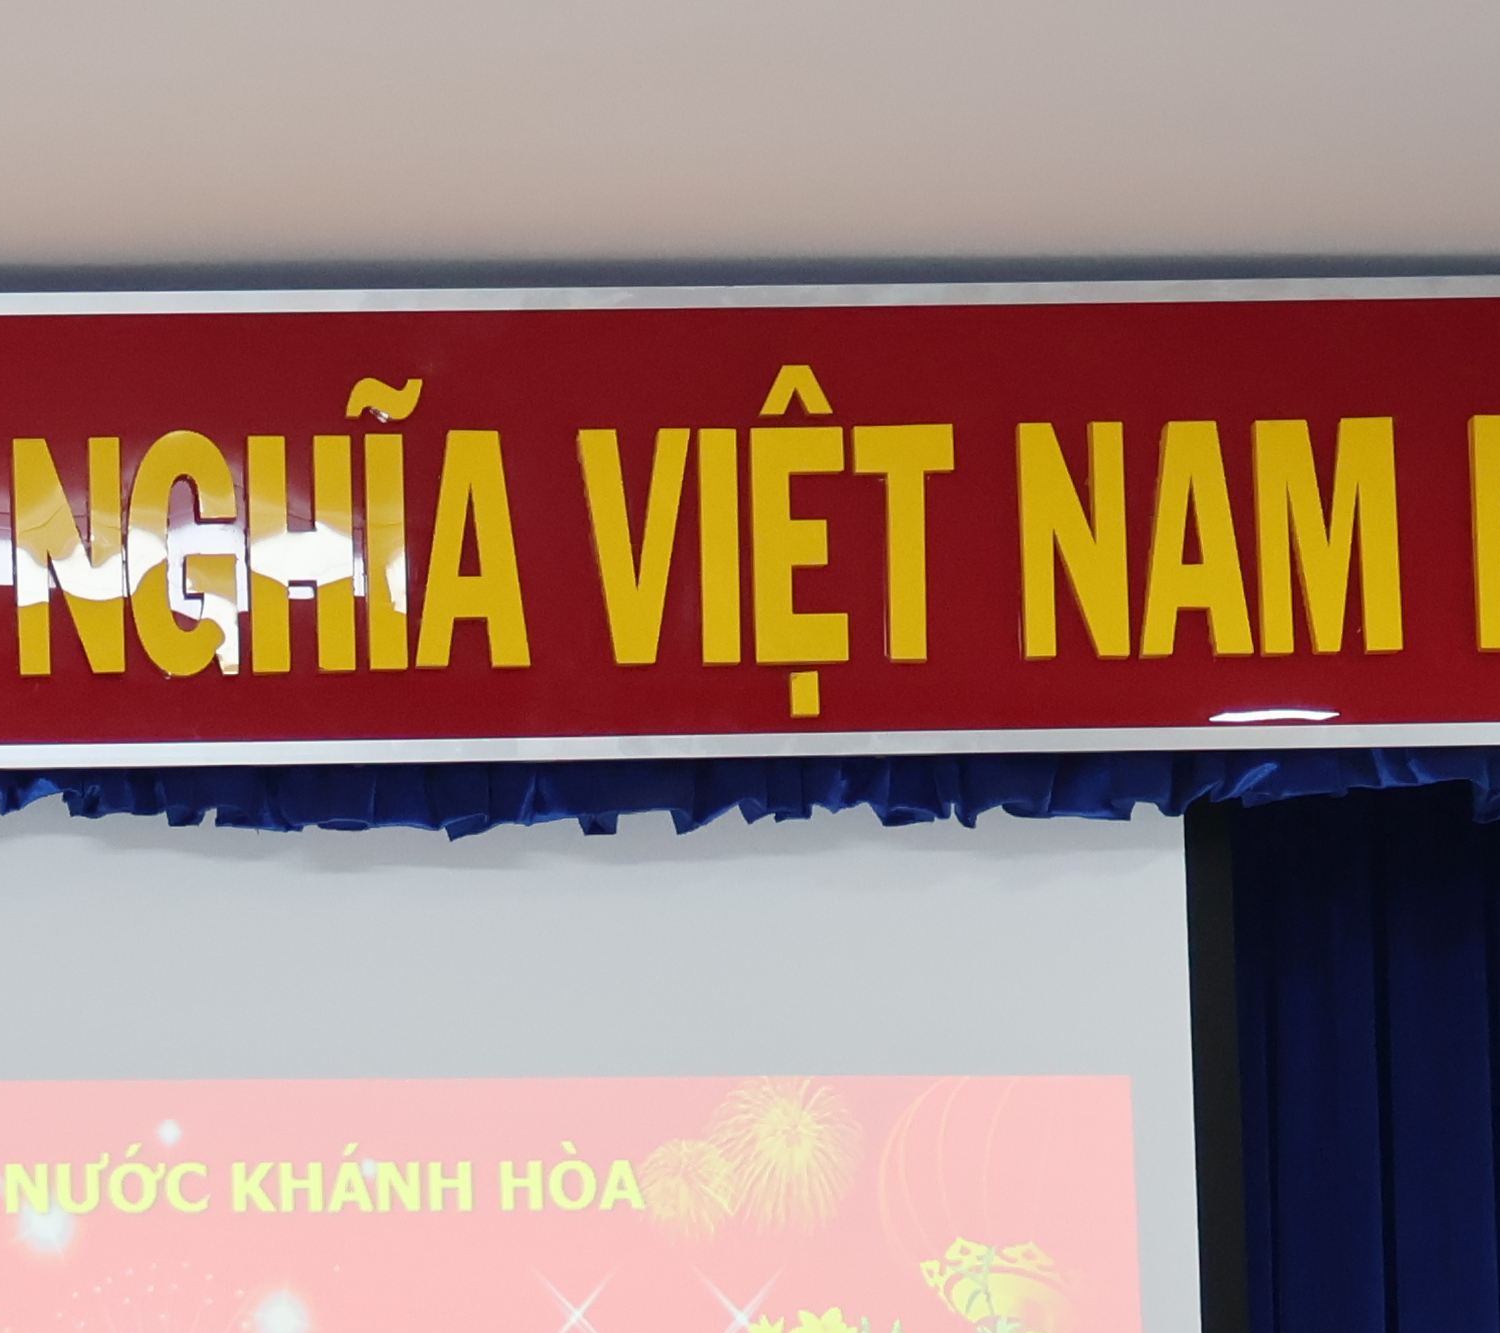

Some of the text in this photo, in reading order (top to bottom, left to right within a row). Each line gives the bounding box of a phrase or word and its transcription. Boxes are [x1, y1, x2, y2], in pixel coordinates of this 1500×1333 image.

[13, 378, 531, 678] NGHĨA
[578, 365, 954, 718] VIỆT
[1018, 417, 1403, 660] NAM
[4, 1143, 208, 1213] NƯỚC
[232, 1143, 473, 1212] KHÁNH
[500, 1142, 647, 1211] HÒA
